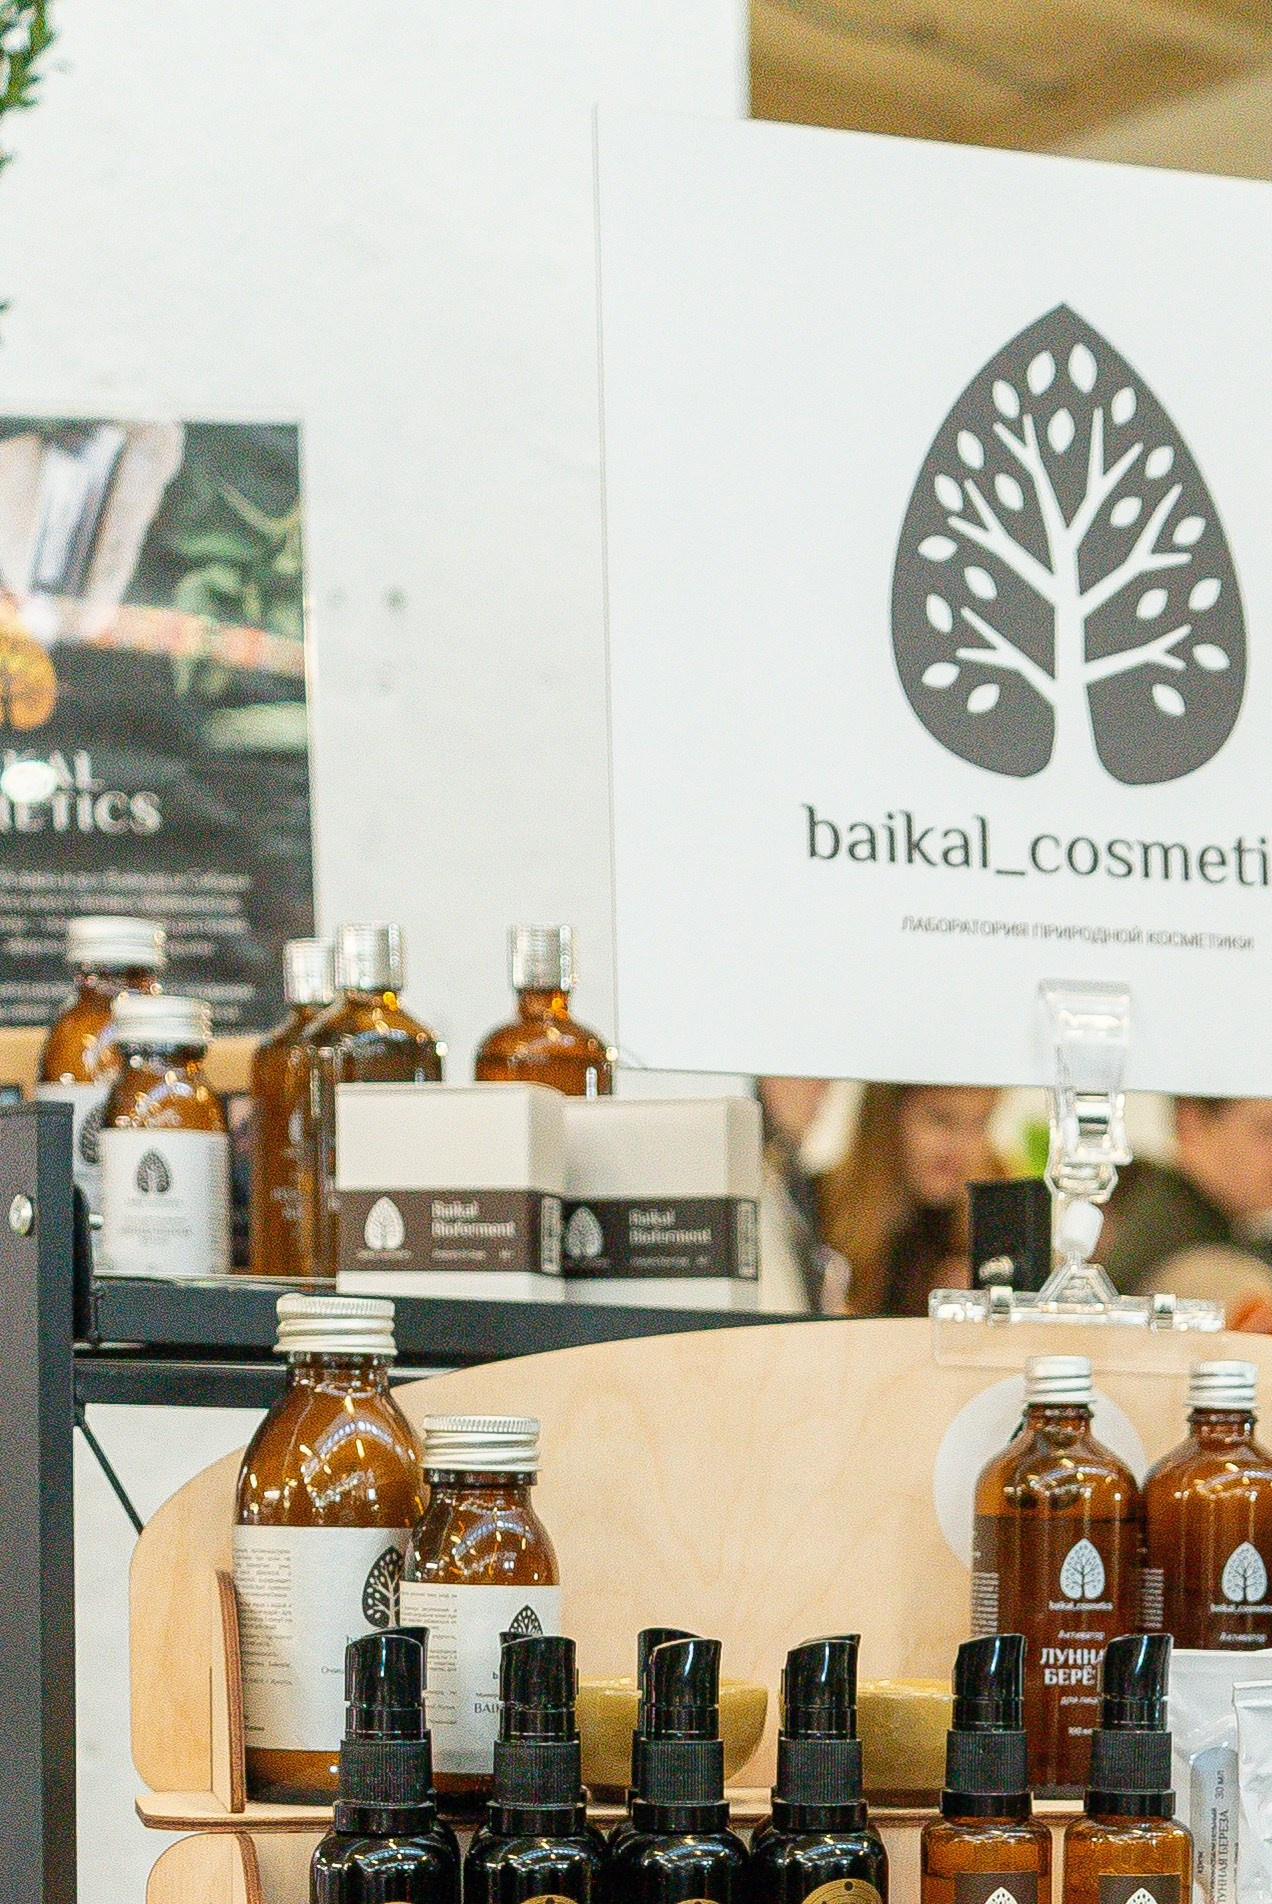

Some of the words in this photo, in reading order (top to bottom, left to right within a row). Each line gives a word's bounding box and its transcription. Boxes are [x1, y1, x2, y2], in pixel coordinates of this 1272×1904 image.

[901, 915, 1029, 938] ЛАБОРАТОРИЯ
[1032, 922, 1142, 945] ПРИРОДНОЙ
[1044, 1665, 1096, 1686] БЕРЁ
